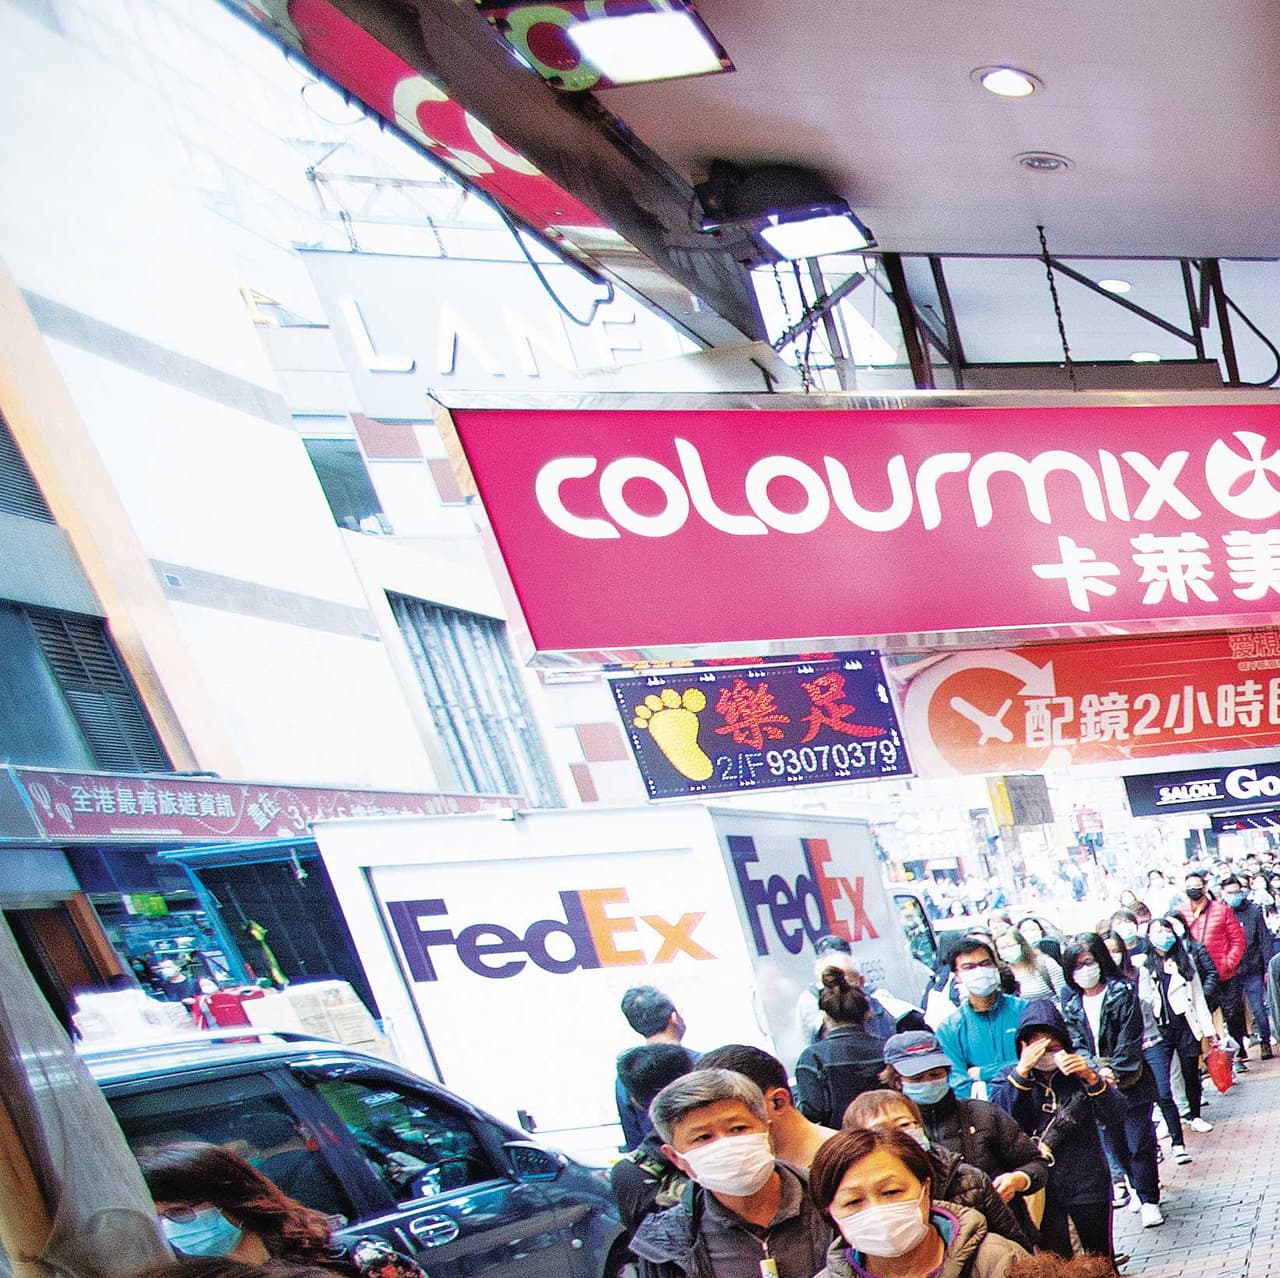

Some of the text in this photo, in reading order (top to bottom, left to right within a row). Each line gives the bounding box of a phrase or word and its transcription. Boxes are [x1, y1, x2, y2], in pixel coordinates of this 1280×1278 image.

[712, 671, 888, 750] 樂足
[766, 738, 899, 778] 93070379
[70, 784, 236, 819] 全港最齊旅遊資訊
[1158, 782, 1218, 802] SALON
[726, 834, 880, 958] FedEx
[387, 886, 719, 983] FedEx
